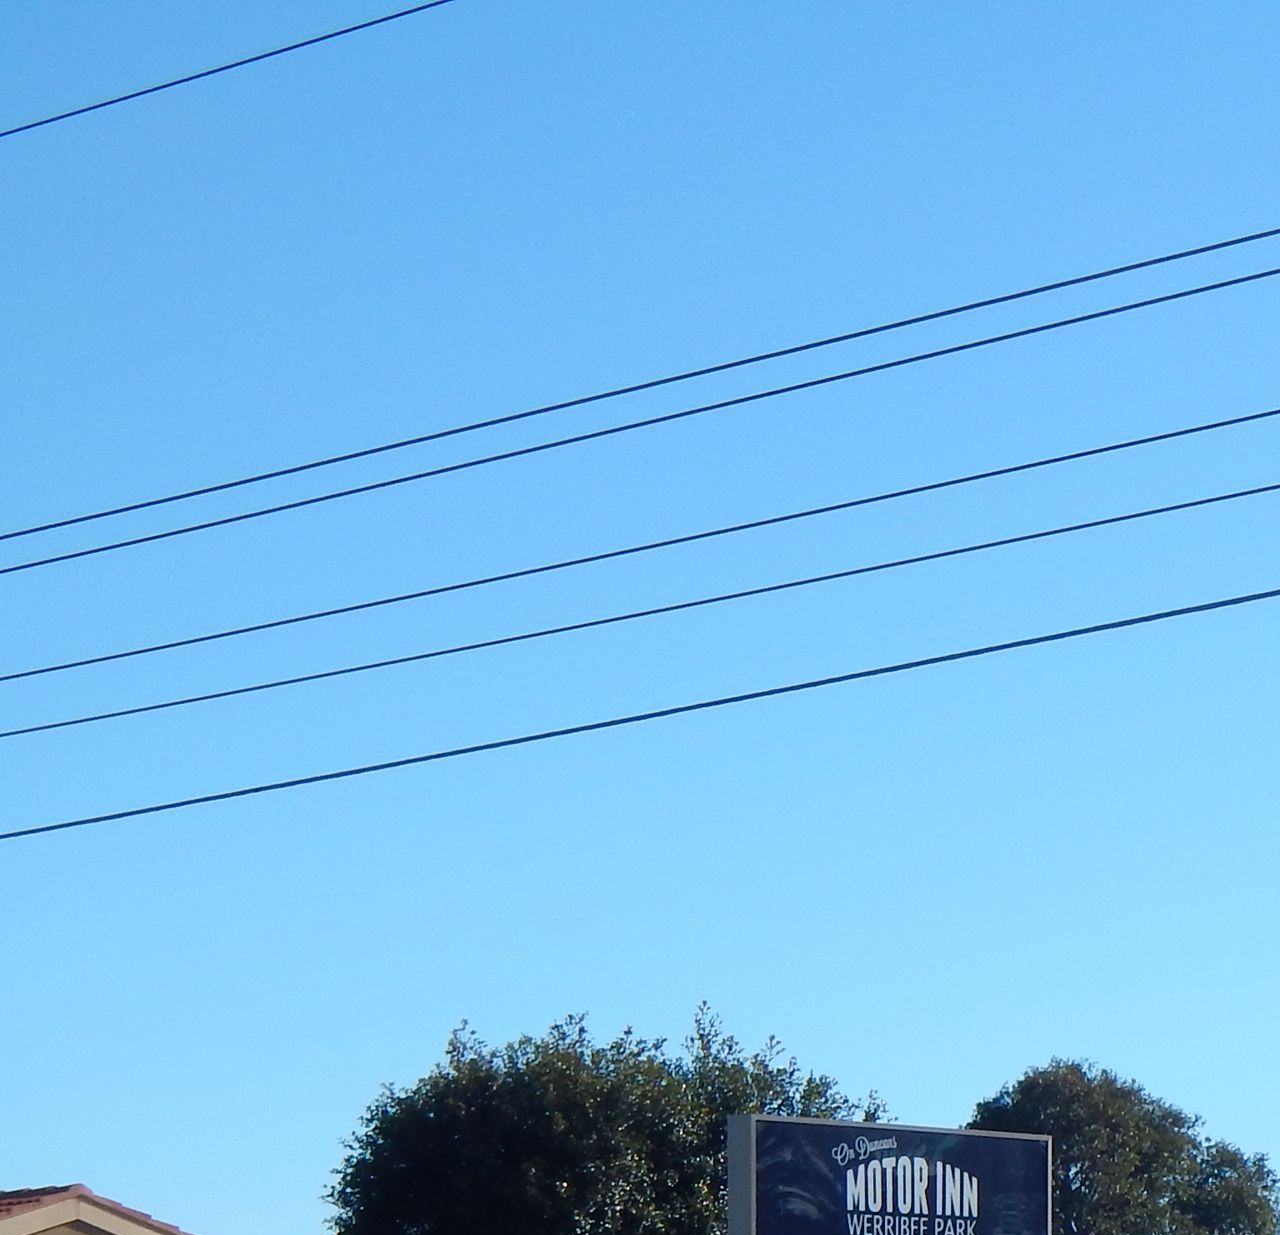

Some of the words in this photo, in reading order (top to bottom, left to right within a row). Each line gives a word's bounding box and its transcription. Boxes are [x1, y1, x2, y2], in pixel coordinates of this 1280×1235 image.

[832, 1143, 856, 1166] On
[855, 1136, 898, 1161] Duncans
[846, 1156, 929, 1215] MOTOR
[936, 1160, 979, 1218] INN
